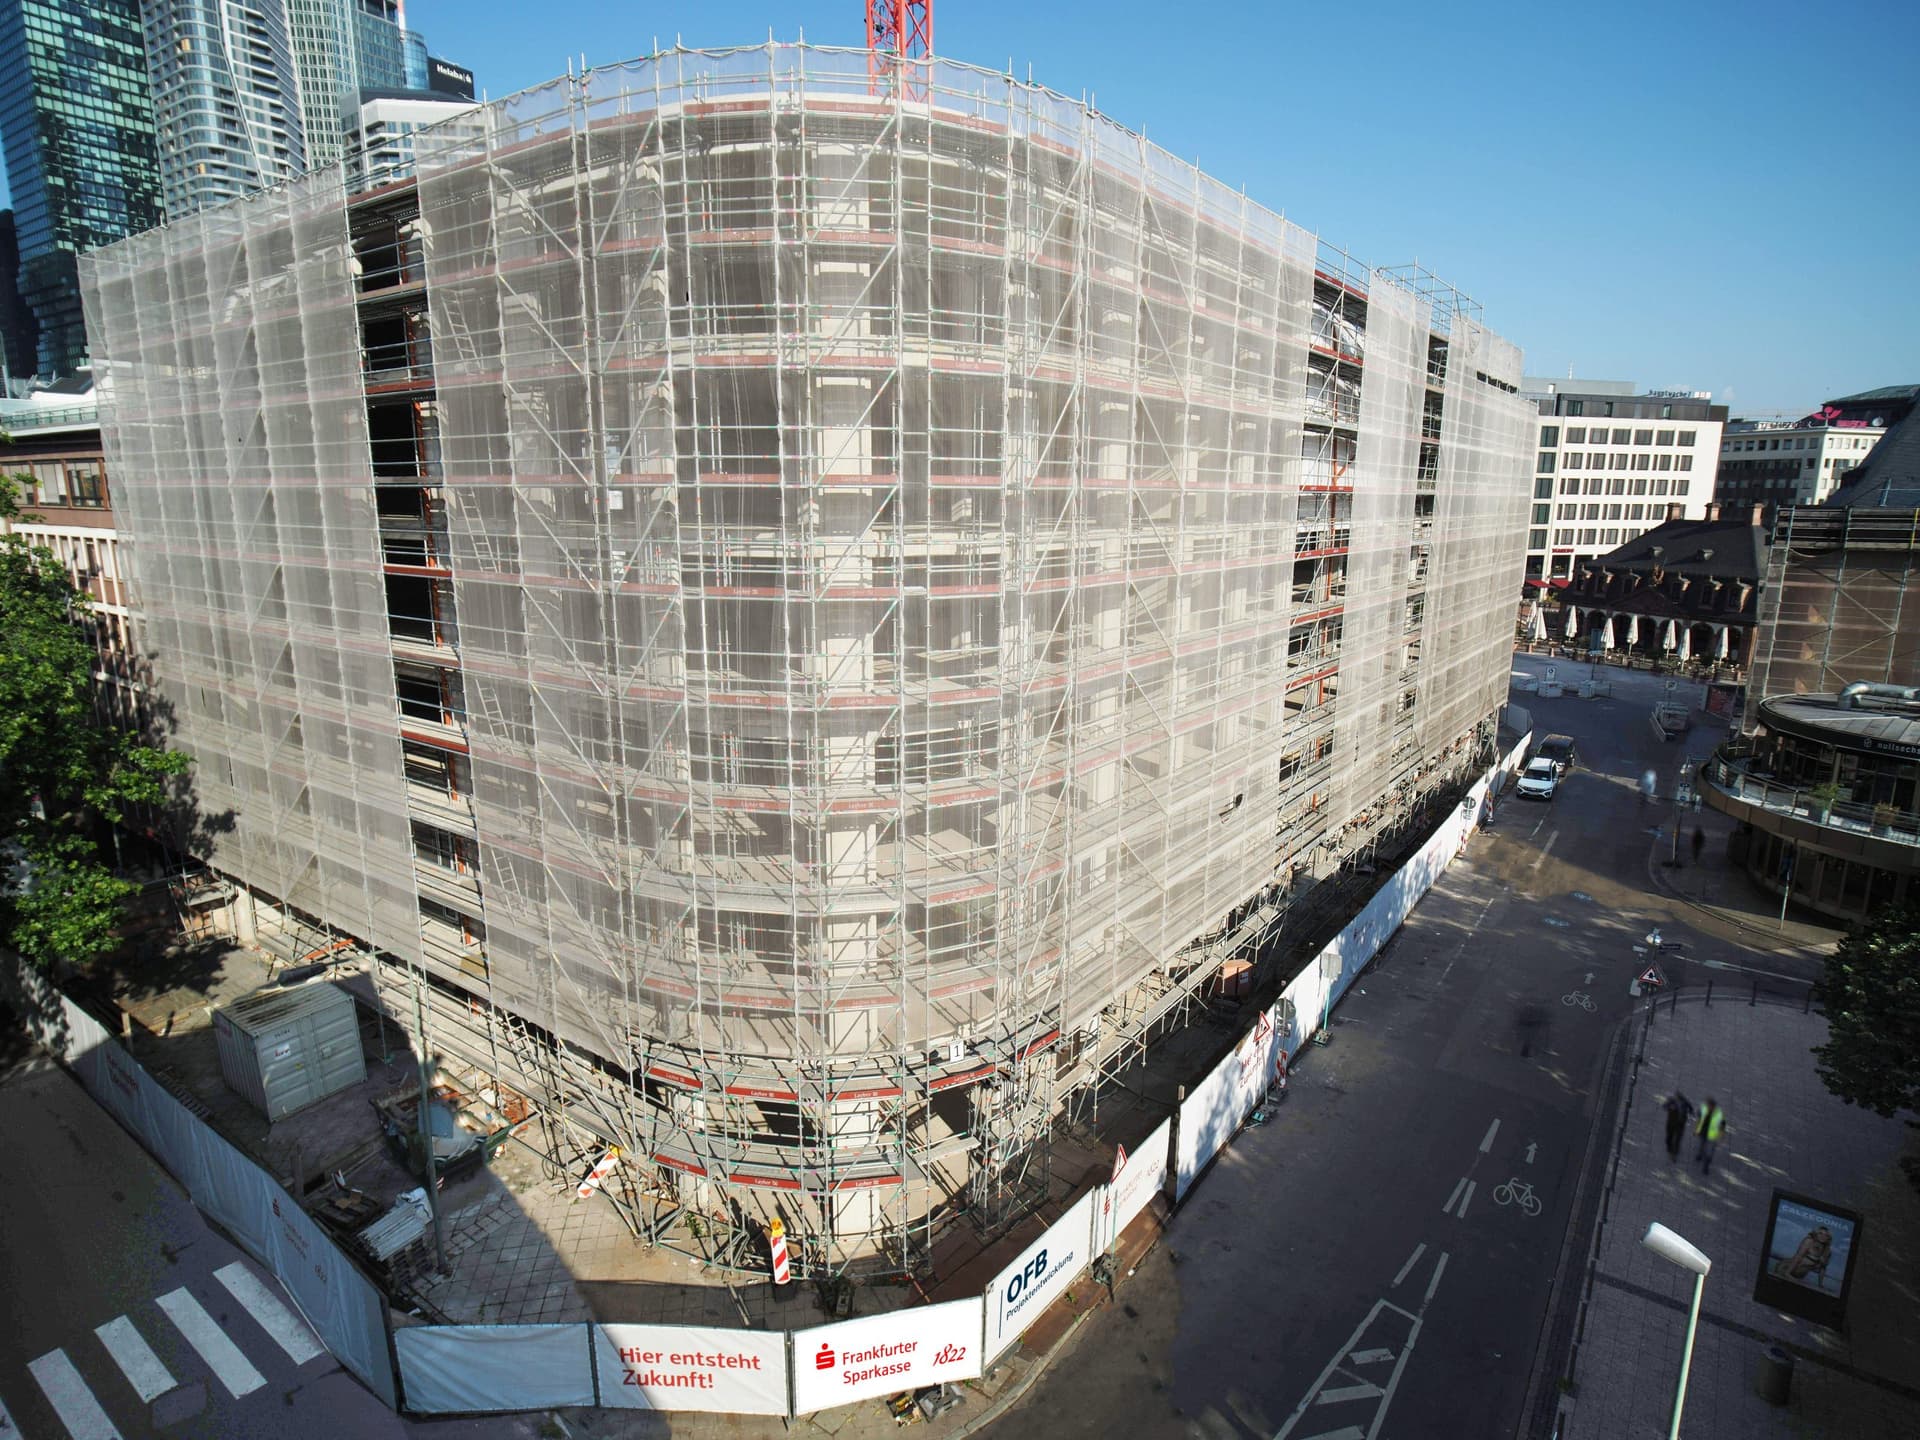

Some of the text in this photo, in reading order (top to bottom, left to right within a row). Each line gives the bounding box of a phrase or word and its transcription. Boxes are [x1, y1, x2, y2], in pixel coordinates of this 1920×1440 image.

[1006, 1251, 1074, 1320] Projektentwicklung
[1007, 1249, 1048, 1303] OFB
[620, 1347, 761, 1370] Hier entsteht
[842, 1341, 918, 1365] Frankfurter
[933, 1343, 967, 1367] 1822
[622, 1369, 714, 1389] Zukunft!
[843, 1362, 912, 1385] Sparkasse
